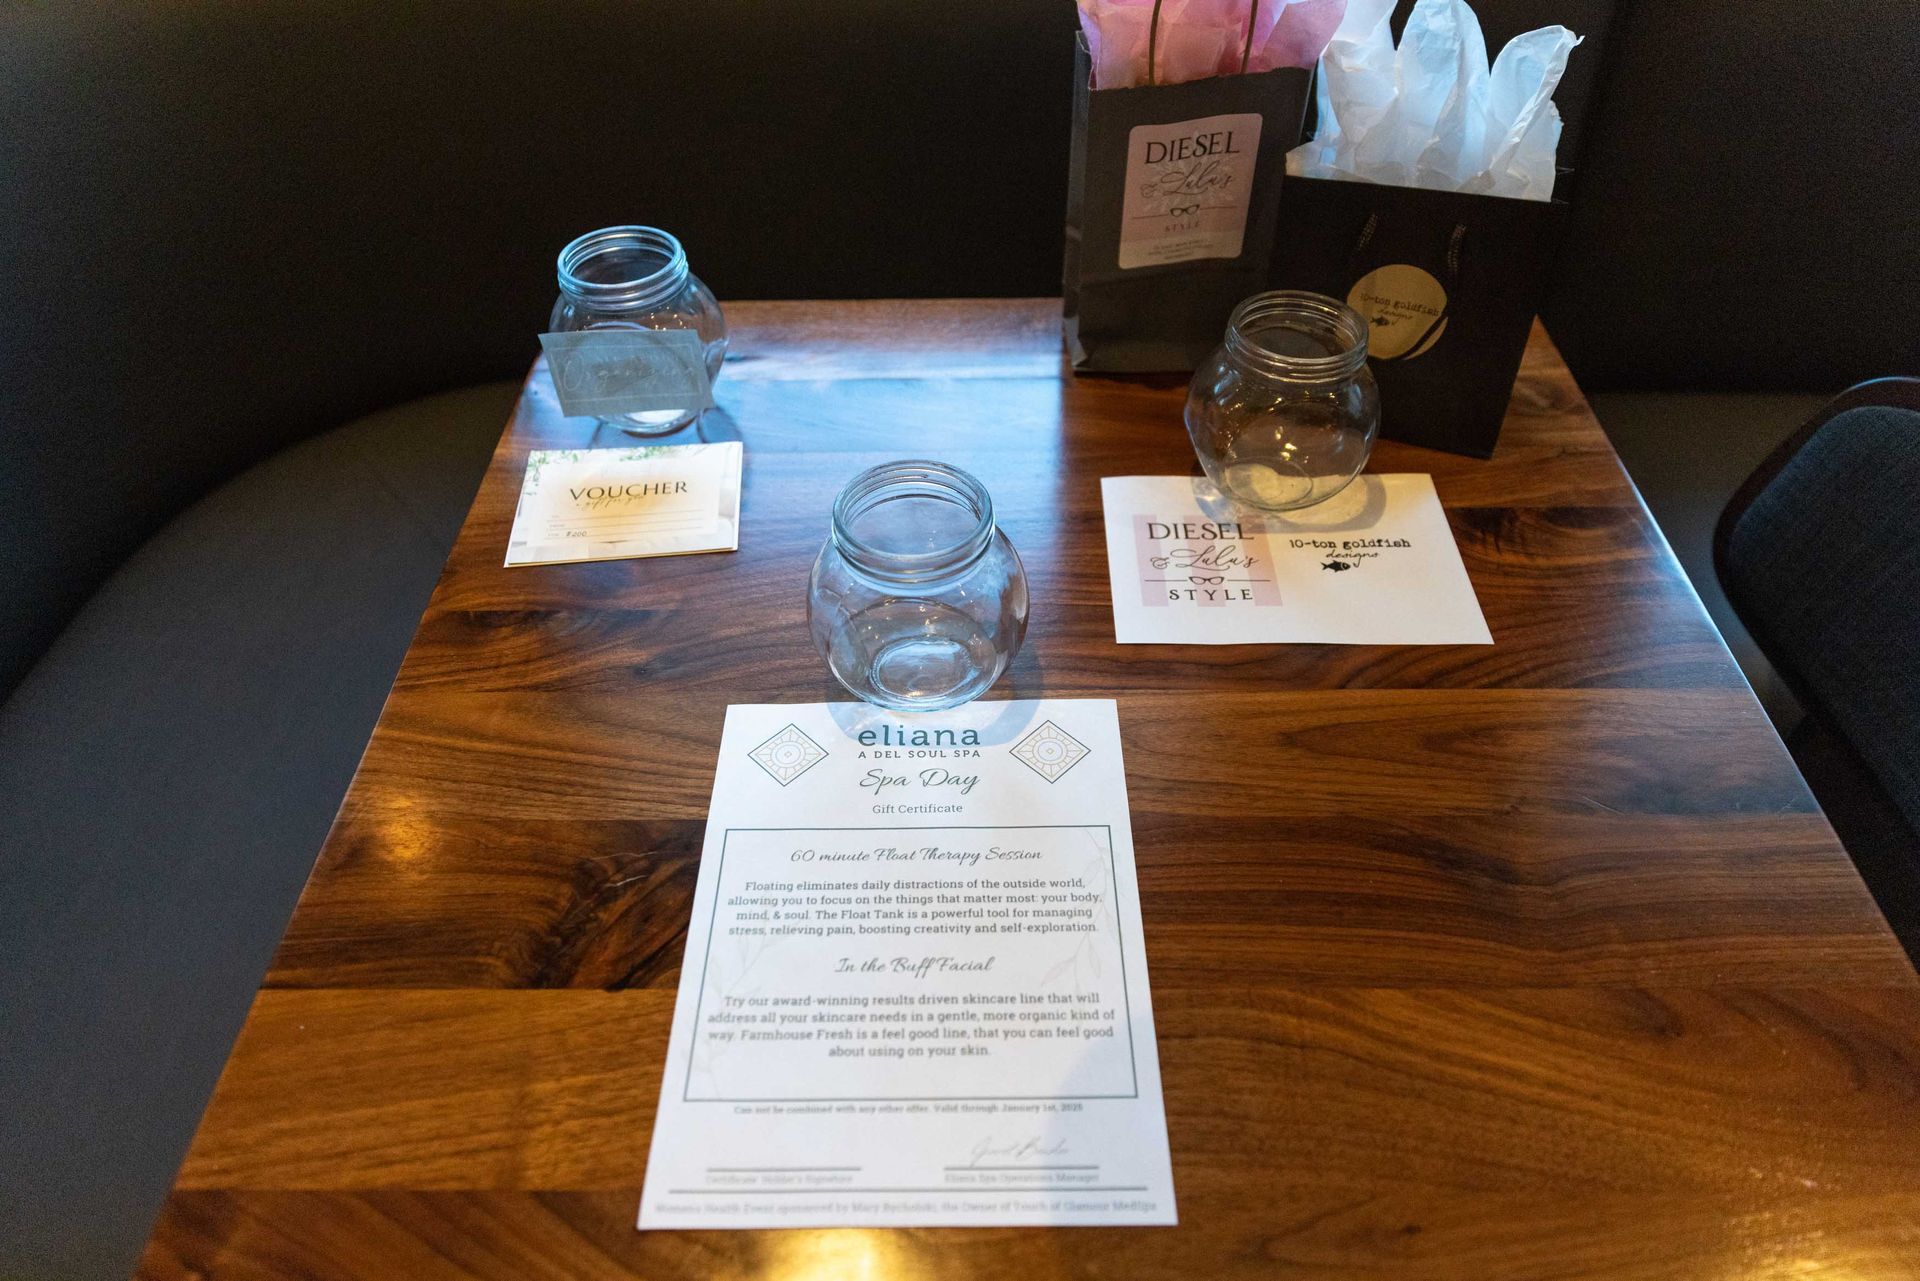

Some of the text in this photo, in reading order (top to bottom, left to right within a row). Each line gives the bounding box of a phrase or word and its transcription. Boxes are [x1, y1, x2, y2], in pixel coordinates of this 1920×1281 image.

[1145, 131, 1240, 164] DIESEL
[569, 481, 688, 500] VOUCHER
[1147, 522, 1255, 541] DIESEL
[1289, 539, 1411, 551] 10-ton goldfish
[1150, 545, 1260, 571] & Lulu's
[1326, 549, 1380, 568] designs
[1169, 589, 1254, 601] STYLE
[857, 724, 981, 747] eliana
[858, 749, 981, 759] A DEL SOUL SPA
[859, 768, 980, 796] Spa Day
[872, 803, 963, 814] Gift Certificate
[791, 846, 1042, 867] 60 minute Float Therapy Session
[745, 877, 1085, 894] Floating eliminates daily distractions of the outside world,
[728, 895, 778, 909] allowing
[782, 897, 802, 908] you
[806, 896, 817, 905] to
[820, 894, 852, 905] focus
[855, 897, 870, 905] on
[873, 894, 892, 905] the
[896, 894, 933, 908] things
[936, 893, 961, 904] that
[963, 894, 1002, 904] matter
[1041, 895, 1068, 906] your
[736, 909, 770, 922] mind,
[773, 909, 781, 920] &
[815, 909, 838, 920] The
[841, 908, 871, 919] Float
[874, 908, 904, 919] Tank
[907, 908, 918, 919] is
[921, 911, 928, 919] a
[931, 907, 984, 921] powerful
[987, 907, 1009, 918] tool
[1013, 907, 1029, 918] for
[1032, 906, 1094, 920] managing
[729, 925, 767, 937] stress,
[770, 923, 823, 937] relieving
[826, 923, 856, 937] pain,
[859, 923, 911, 937] boosting
[914, 922, 971, 936] creativity
[974, 922, 997, 933] and
[834, 955, 993, 979] In the Buff Facial
[725, 992, 1100, 1011] Try our award-winning results driven skincare line that will
[708, 1008, 1115, 1027] address all your skincare needs in a gentle, more organic kind of
[741, 1028, 813, 1040] Farmhouse
[815, 1028, 853, 1040] Fresh
[856, 1027, 868, 1039] is
[871, 1030, 879, 1039] a
[882, 1027, 905, 1039] feel
[908, 1027, 939, 1042] good
[942, 1027, 970, 1041] line,
[973, 1026, 999, 1038] that
[1002, 1029, 1026, 1041] you
[1029, 1029, 1053, 1038] can
[1056, 1025, 1081, 1037] feel
[1083, 1025, 1114, 1041] good
[828, 1043, 991, 1060] about using on your skin.
